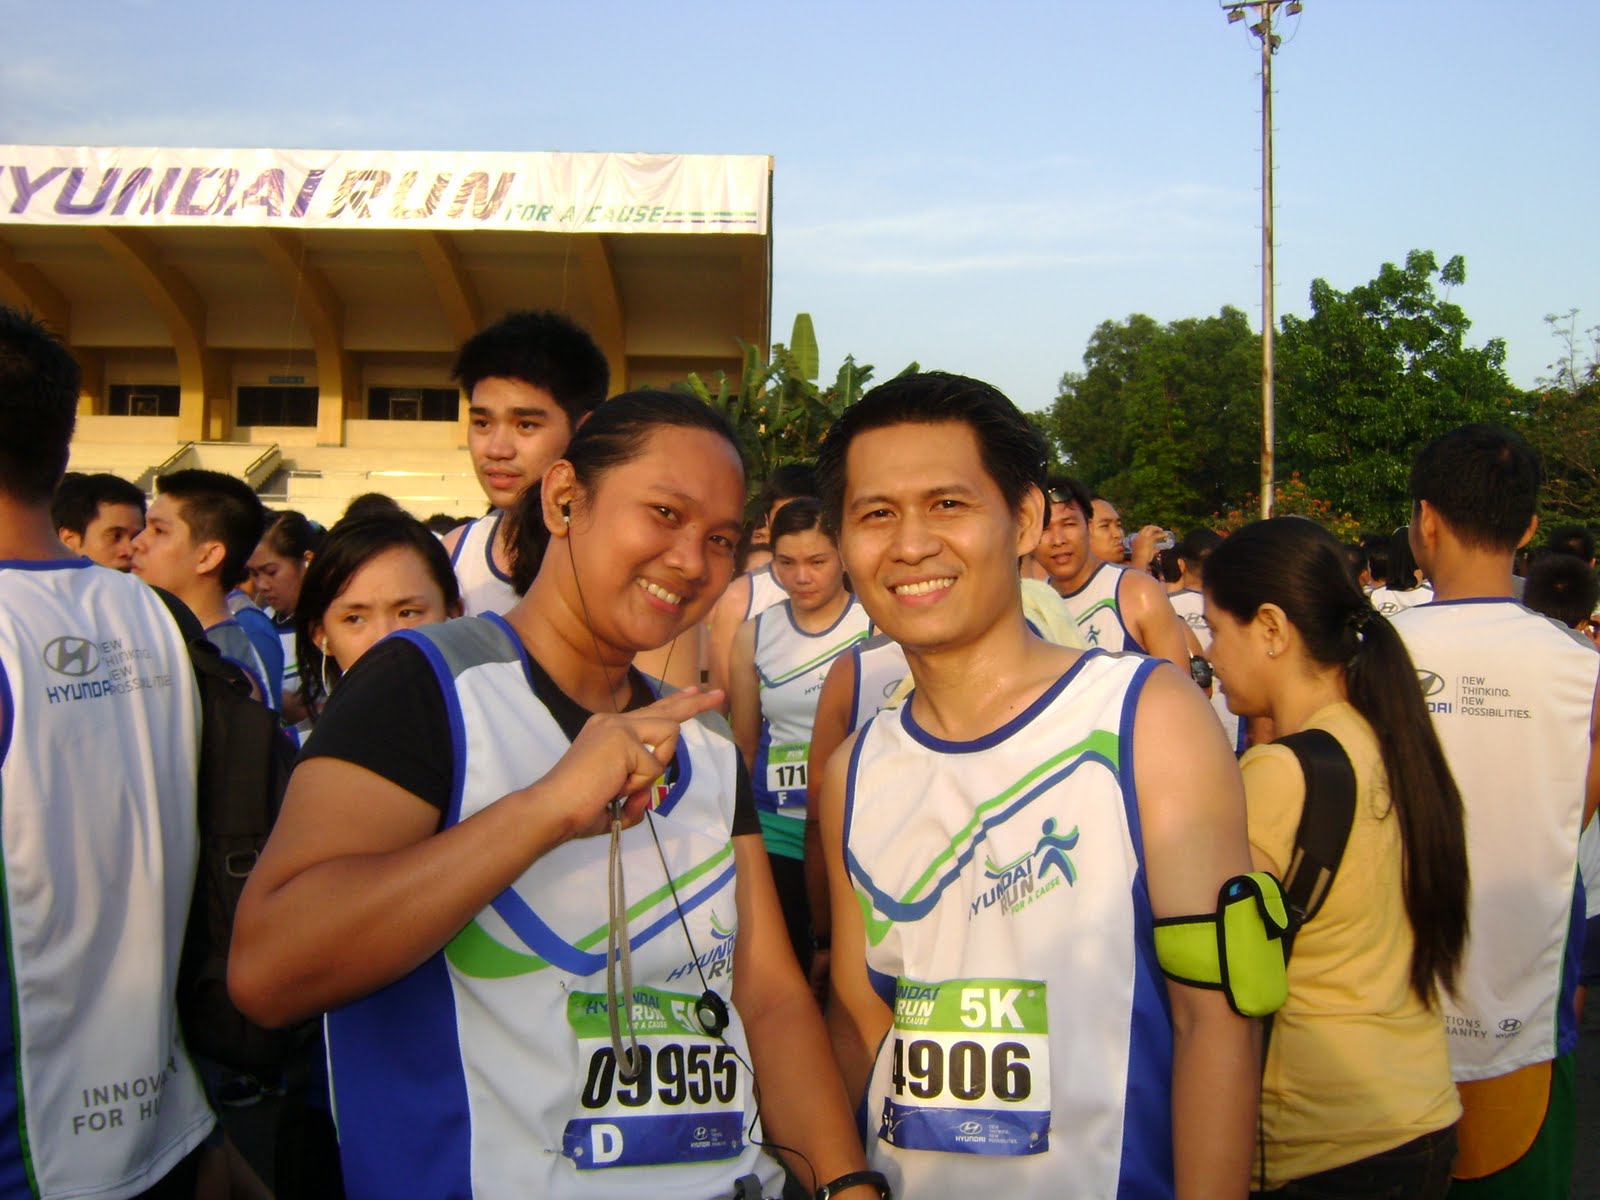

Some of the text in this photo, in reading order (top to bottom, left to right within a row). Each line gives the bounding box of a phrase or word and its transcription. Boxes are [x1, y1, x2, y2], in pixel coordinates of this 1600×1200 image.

[0, 166, 516, 220] YUNDAI RUN
[505, 203, 665, 223] FOR A CAUSE
[1461, 676, 1485, 685] NEW
[1461, 686, 1511, 697] THINKING.
[1461, 697, 1484, 705] NEW
[1461, 707, 1532, 719] POSSIBILITIES.
[776, 765, 806, 787] 171
[778, 791, 787, 805] F
[1000, 874, 1033, 916] RUN
[1011, 900, 1025, 915] FOR
[1036, 875, 1060, 898] CAUSE
[632, 1004, 666, 1021] RUN
[897, 1000, 935, 1017] RUN
[960, 988, 1024, 1028] 5K
[581, 1043, 737, 1109] 09955
[72, 1108, 124, 1135] FOR
[591, 1123, 624, 1163] D
